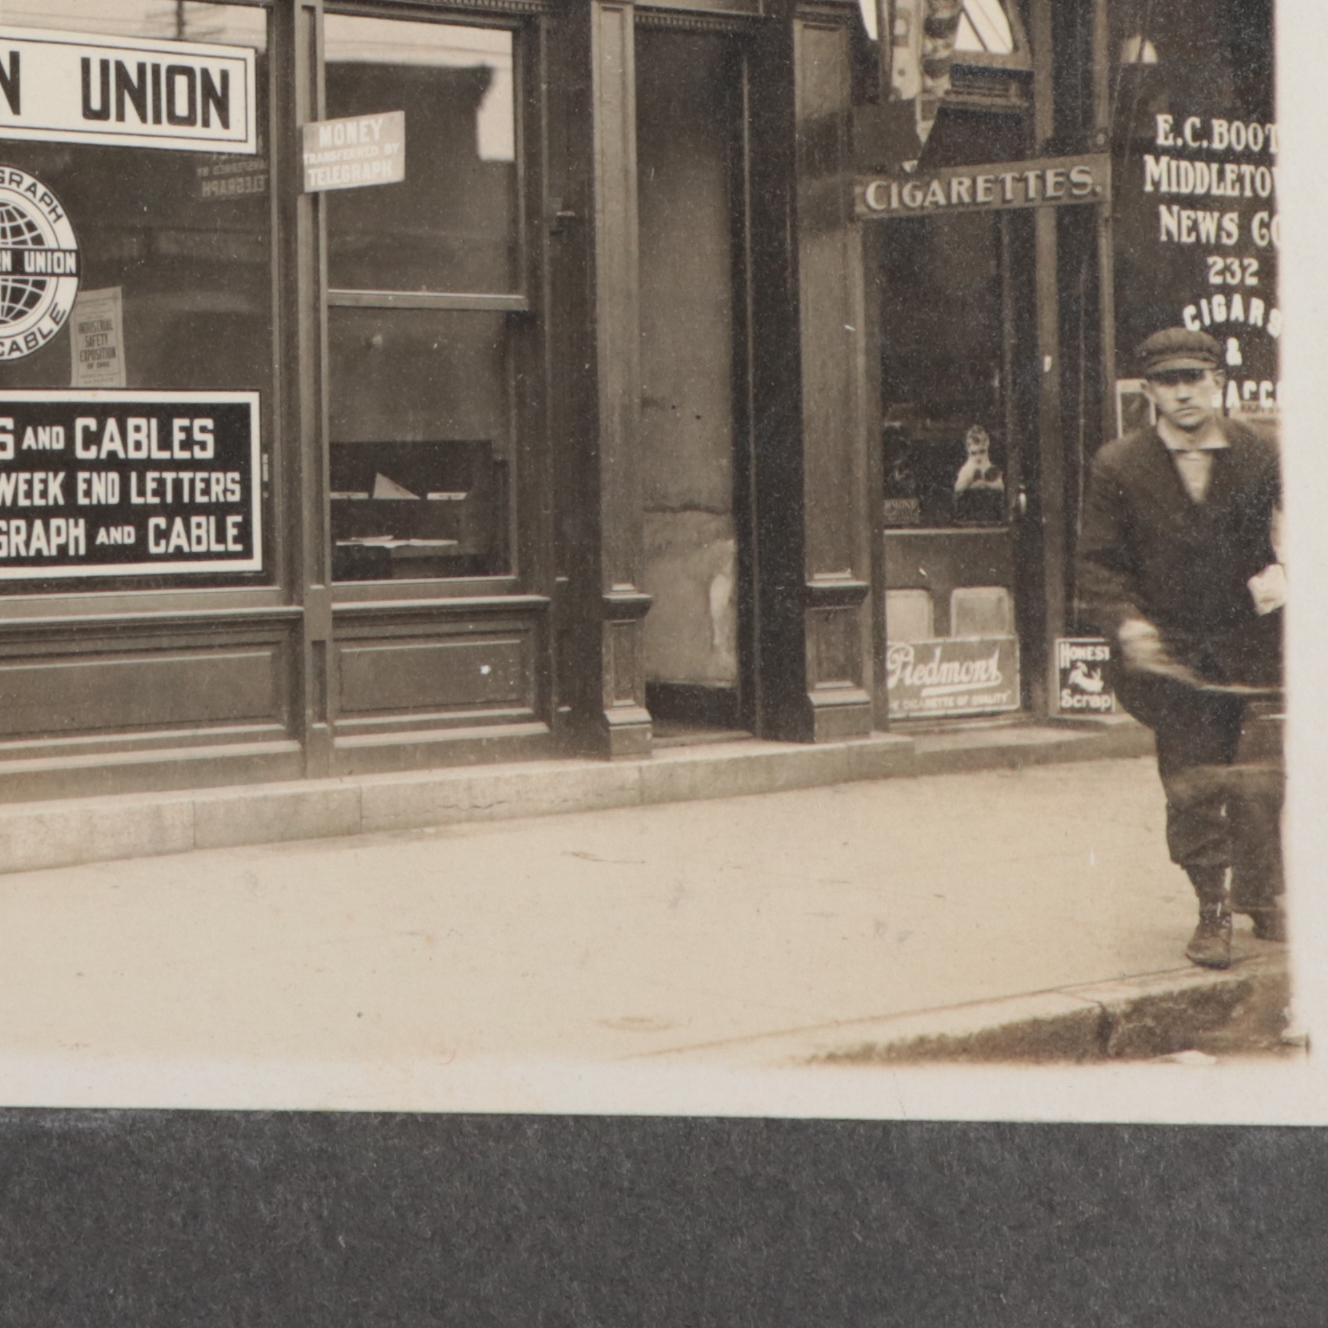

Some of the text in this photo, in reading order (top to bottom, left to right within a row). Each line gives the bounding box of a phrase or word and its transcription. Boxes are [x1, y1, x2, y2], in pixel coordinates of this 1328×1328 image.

[80, 56, 231, 130] UNION
[319, 119, 383, 148] MONEY
[308, 160, 392, 186] TELEGRAPH
[1144, 154, 1280, 198] MIDDLETO
[1159, 205, 1239, 246] NEWS
[24, 250, 77, 274] UNION
[1207, 256, 1259, 286] 232
[1226, 337, 1242, 366] &
[22, 426, 64, 450] AND
[74, 418, 214, 460] CABLES
[77, 473, 120, 505] END
[129, 473, 242, 504] LETTERS
[96, 527, 136, 546] AND
[148, 515, 243, 554] CABLE
[886, 642, 1002, 696] Piedmont
